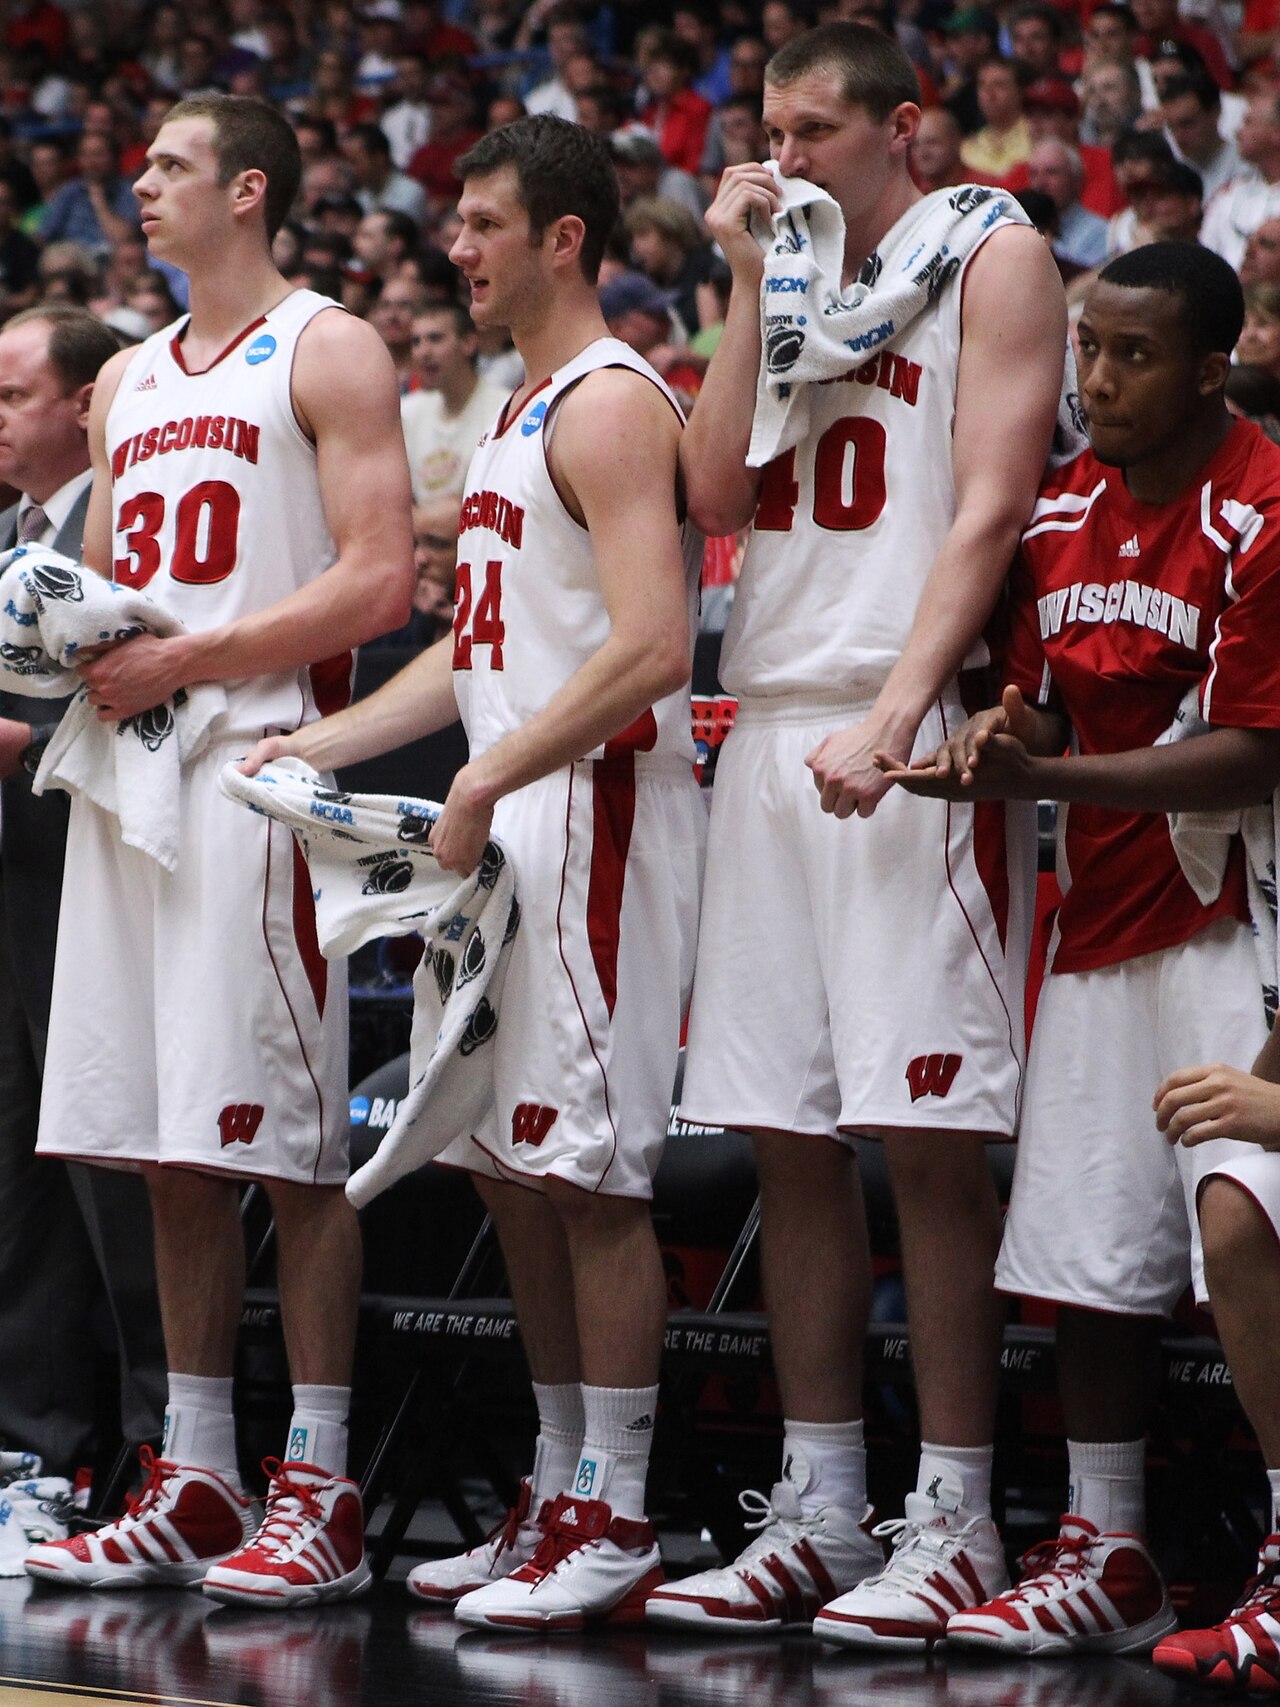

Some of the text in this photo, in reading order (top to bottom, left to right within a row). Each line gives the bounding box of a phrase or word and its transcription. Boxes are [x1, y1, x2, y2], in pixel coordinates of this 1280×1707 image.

[754, 416, 887, 531] 40
[114, 480, 240, 592] 30
[452, 560, 505, 671] 24
[905, 1054, 963, 1104] W
[217, 1104, 265, 1149] W
[368, 1097, 404, 1128] BA
[511, 1103, 559, 1147] W
[393, 1311, 515, 1338] WE ARE THE GAME
[685, 1331, 715, 1353] THE
[718, 1334, 762, 1356] GAME
[883, 1338, 908, 1360] WE
[1168, 1361, 1232, 1385] WE ARE
